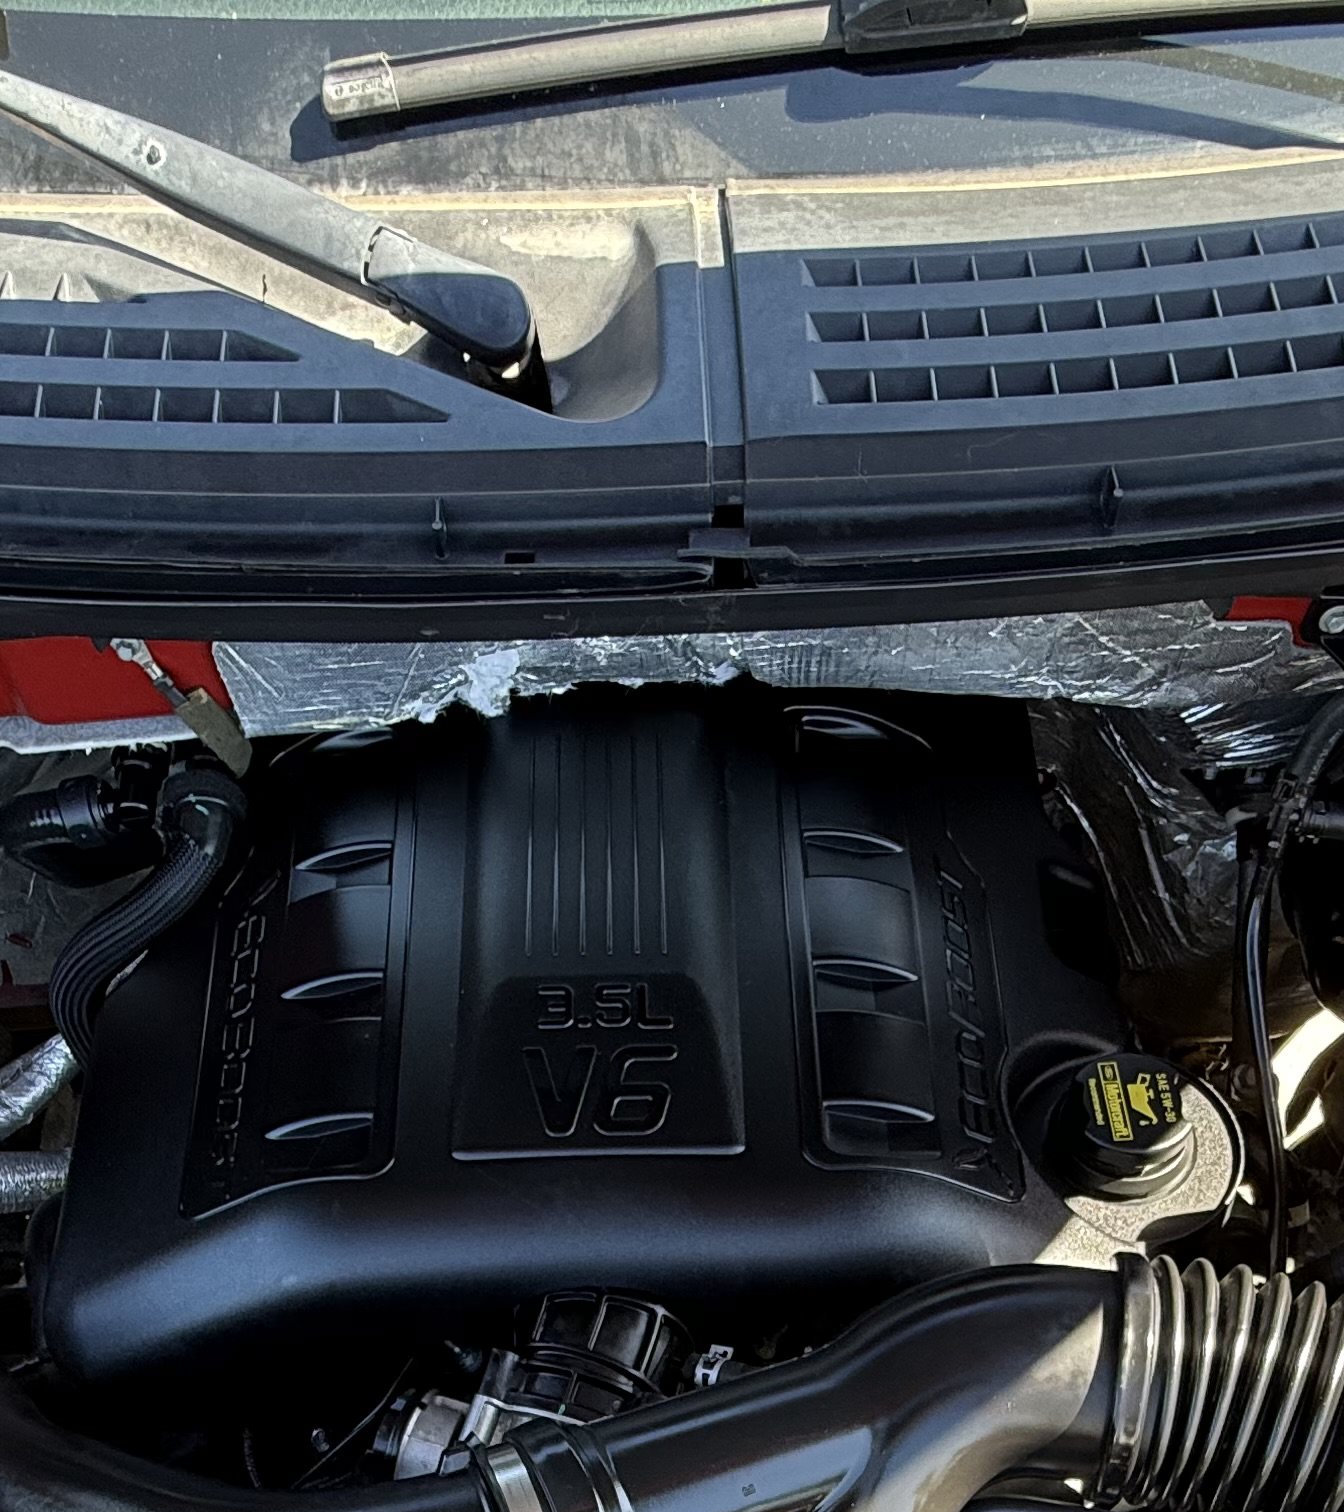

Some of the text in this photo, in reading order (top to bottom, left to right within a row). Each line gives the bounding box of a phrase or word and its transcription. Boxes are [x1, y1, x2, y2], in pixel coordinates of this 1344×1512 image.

[537, 983, 674, 1029] 3.5L
[524, 1043, 679, 1137] V6
[1103, 1082, 1130, 1139] Motorcraft
[1156, 1073, 1177, 1122] SAE 5W-30
